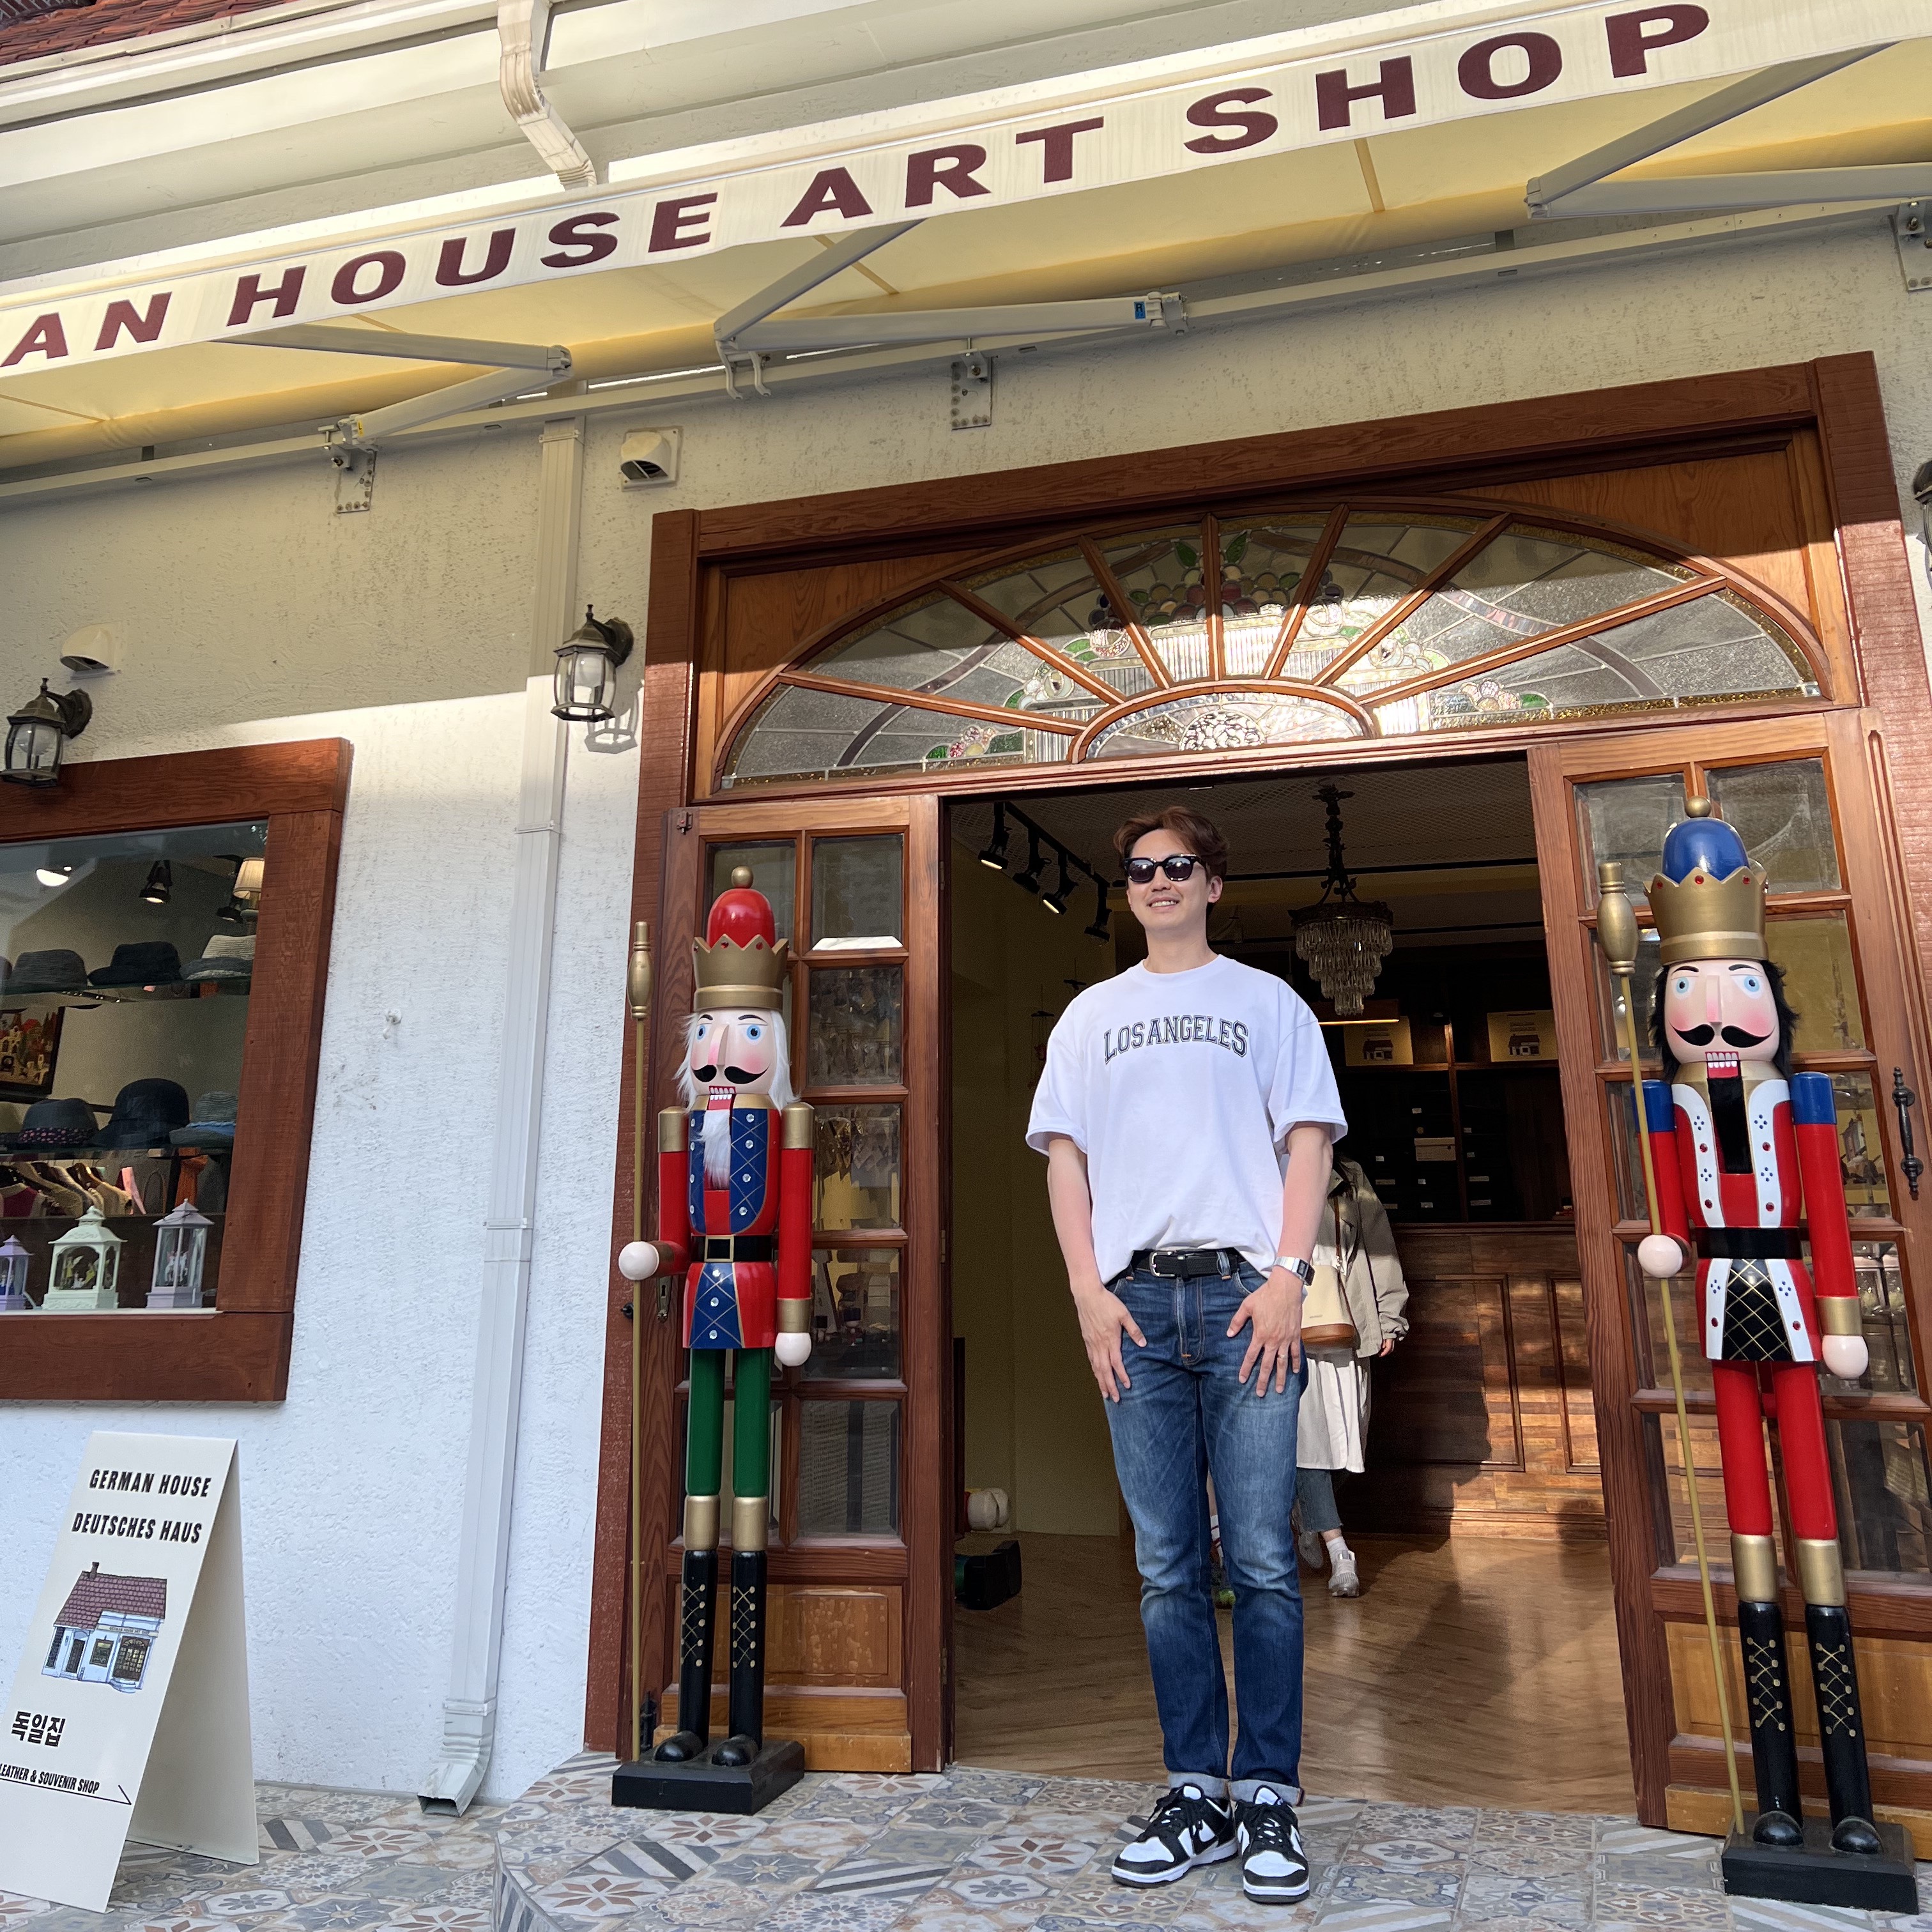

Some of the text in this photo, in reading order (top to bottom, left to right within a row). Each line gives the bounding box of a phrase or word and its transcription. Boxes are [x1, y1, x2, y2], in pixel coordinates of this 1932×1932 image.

[0, 3, 1710, 367] AN HOUSE ART SHOP
[89, 1469, 211, 1498] GERMAN HOUSE
[72, 1512, 202, 1544] DEUTSCHES HAUS
[11, 1711, 66, 1747] 독일집
[30, 1770, 37, 1782] &
[38, 1771, 77, 1790] SOUVENIR
[77, 1778, 100, 1794] SHOP
